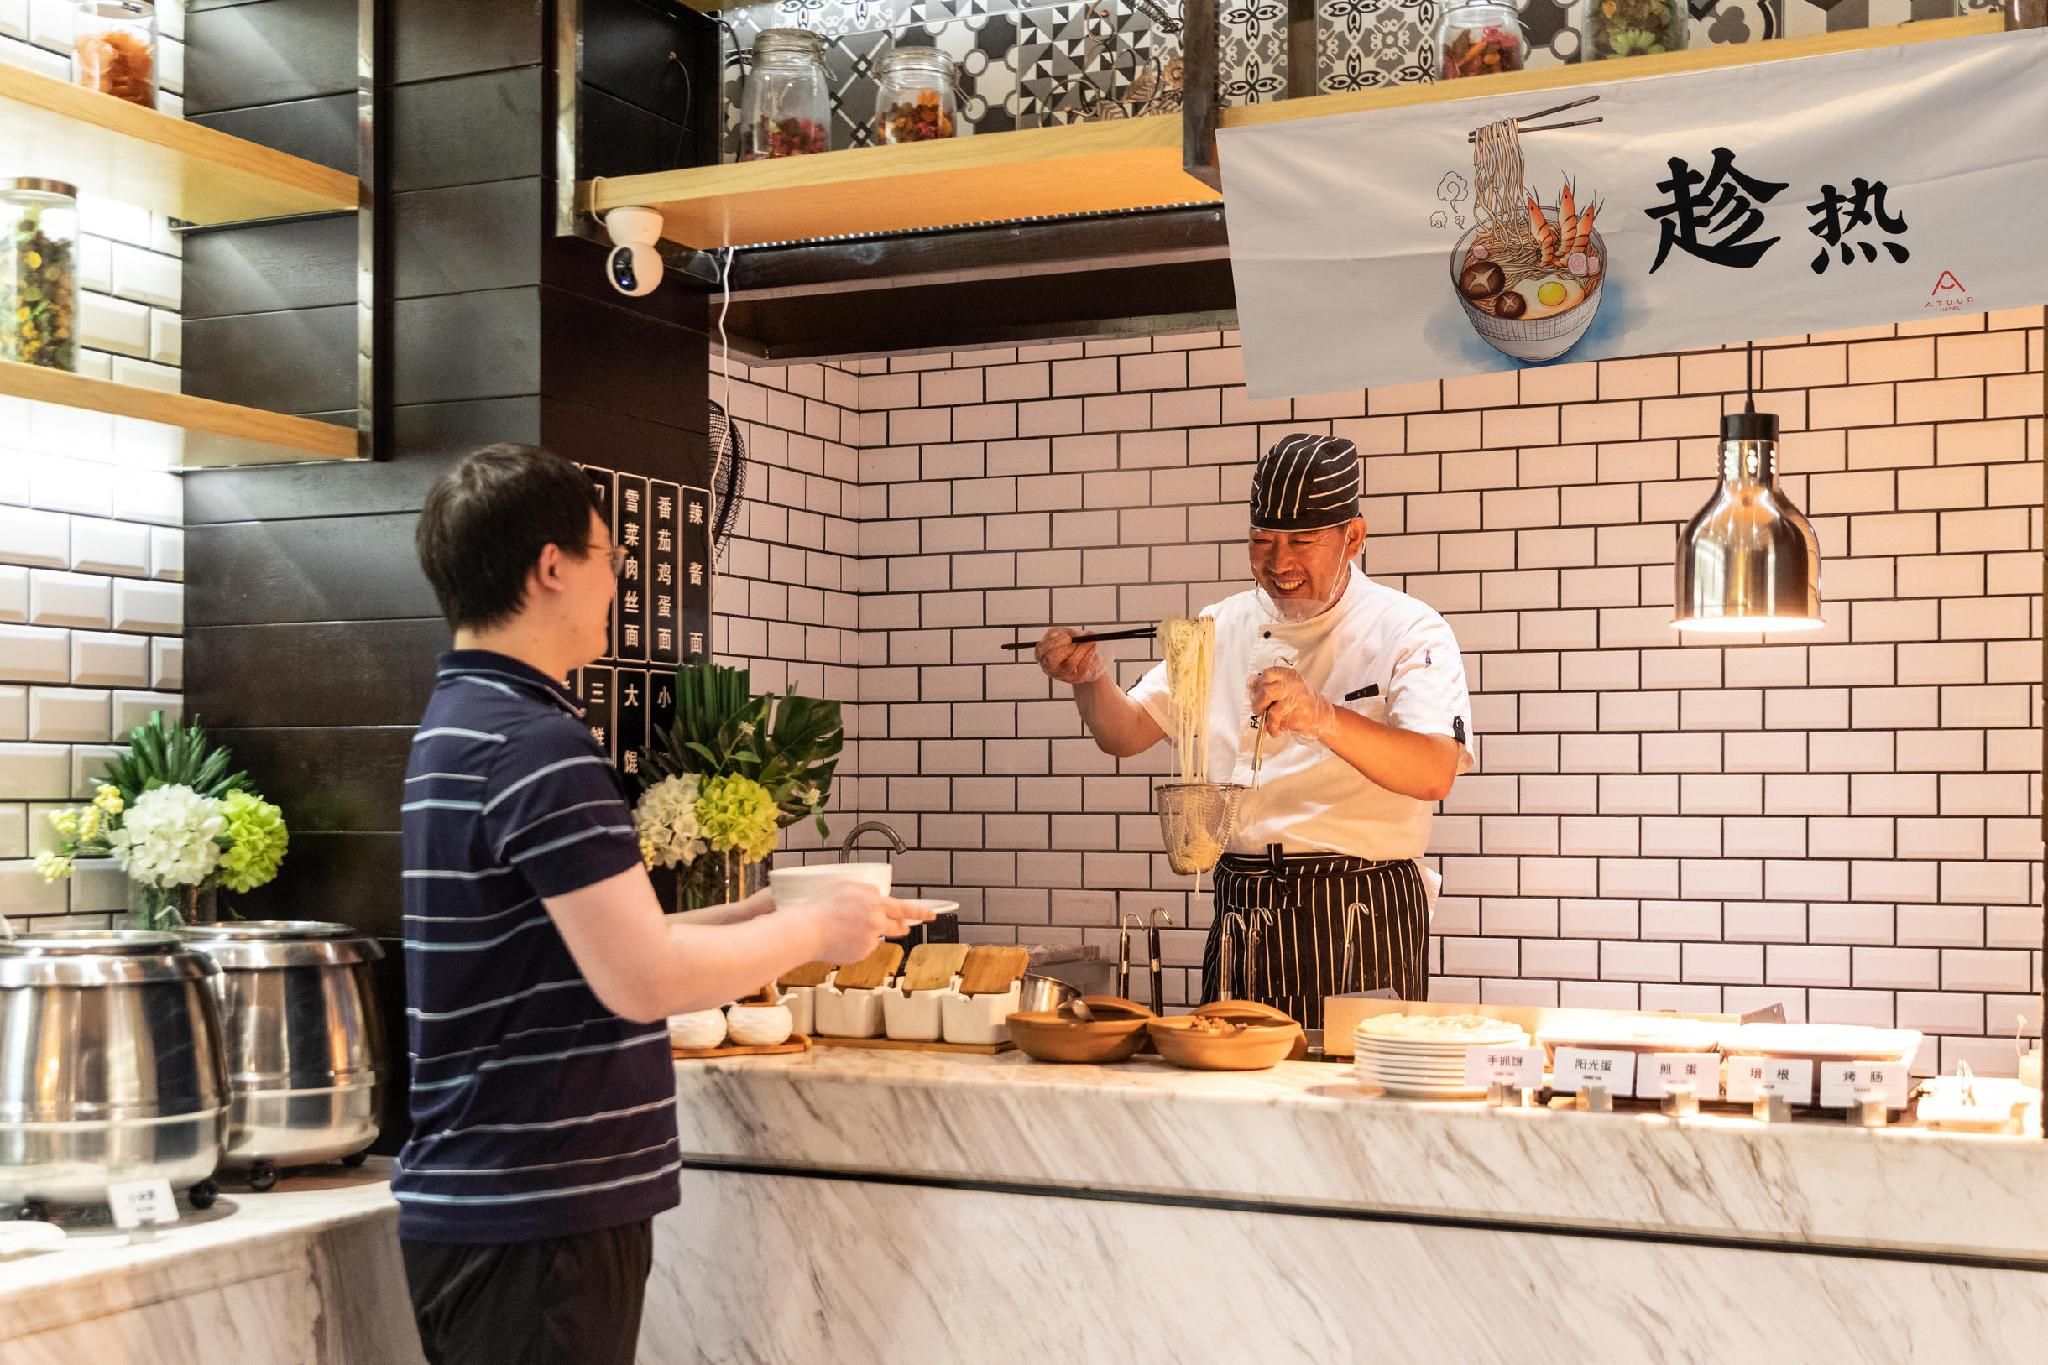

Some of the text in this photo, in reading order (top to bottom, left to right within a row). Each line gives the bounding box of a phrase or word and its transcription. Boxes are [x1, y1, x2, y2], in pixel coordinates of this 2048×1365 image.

[1645, 148, 1909, 274] 趁热
[623, 488, 640, 648] 雪菜肉丝面
[656, 495, 672, 651] 番茄鸡蛋面
[688, 501, 704, 655] 辣酱面
[1574, 1057, 1612, 1072] 阳光蛋
